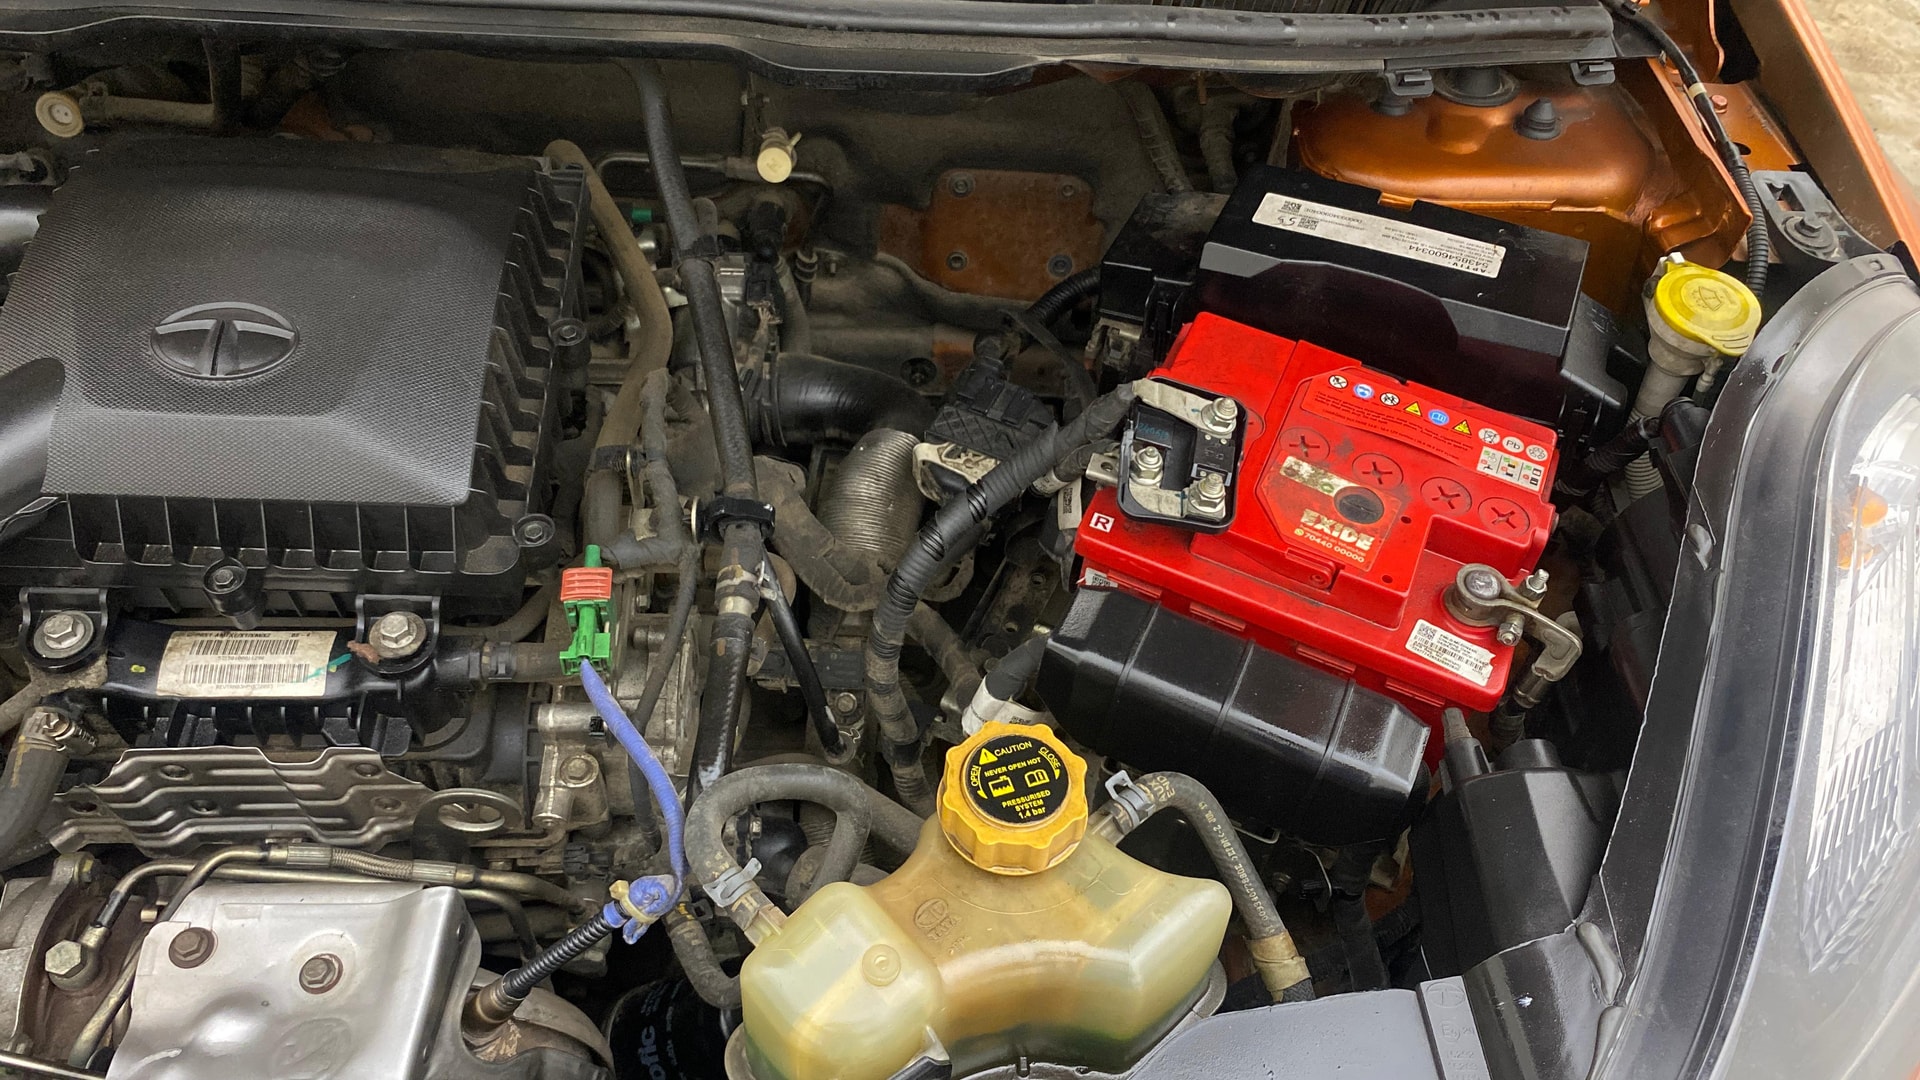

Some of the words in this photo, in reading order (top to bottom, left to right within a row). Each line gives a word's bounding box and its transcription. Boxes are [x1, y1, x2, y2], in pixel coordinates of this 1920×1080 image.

[1408, 245, 1489, 268] 543854600344
[1452, 262, 1487, 273] APTIV
[1506, 440, 1521, 450] Pb
[1094, 516, 1110, 530] R
[1300, 509, 1375, 551] EXIDE
[1303, 532, 1333, 549] 70440
[1334, 545, 1365, 563] 00000
[994, 741, 1033, 757] CAUTION
[1039, 747, 1062, 769] CLOSE
[970, 764, 981, 787] OPEN
[984, 766, 1006, 777] NEVER
[1007, 761, 1027, 770] OPEN
[1027, 757, 1041, 767] HOT
[1149, 779, 1167, 802] AUX
[1157, 775, 1176, 799] END
[1001, 789, 1051, 808] PRESSURISED
[1015, 799, 1044, 813] SYSTEM
[1018, 809, 1031, 819] 1.4
[1032, 806, 1046, 817] bar
